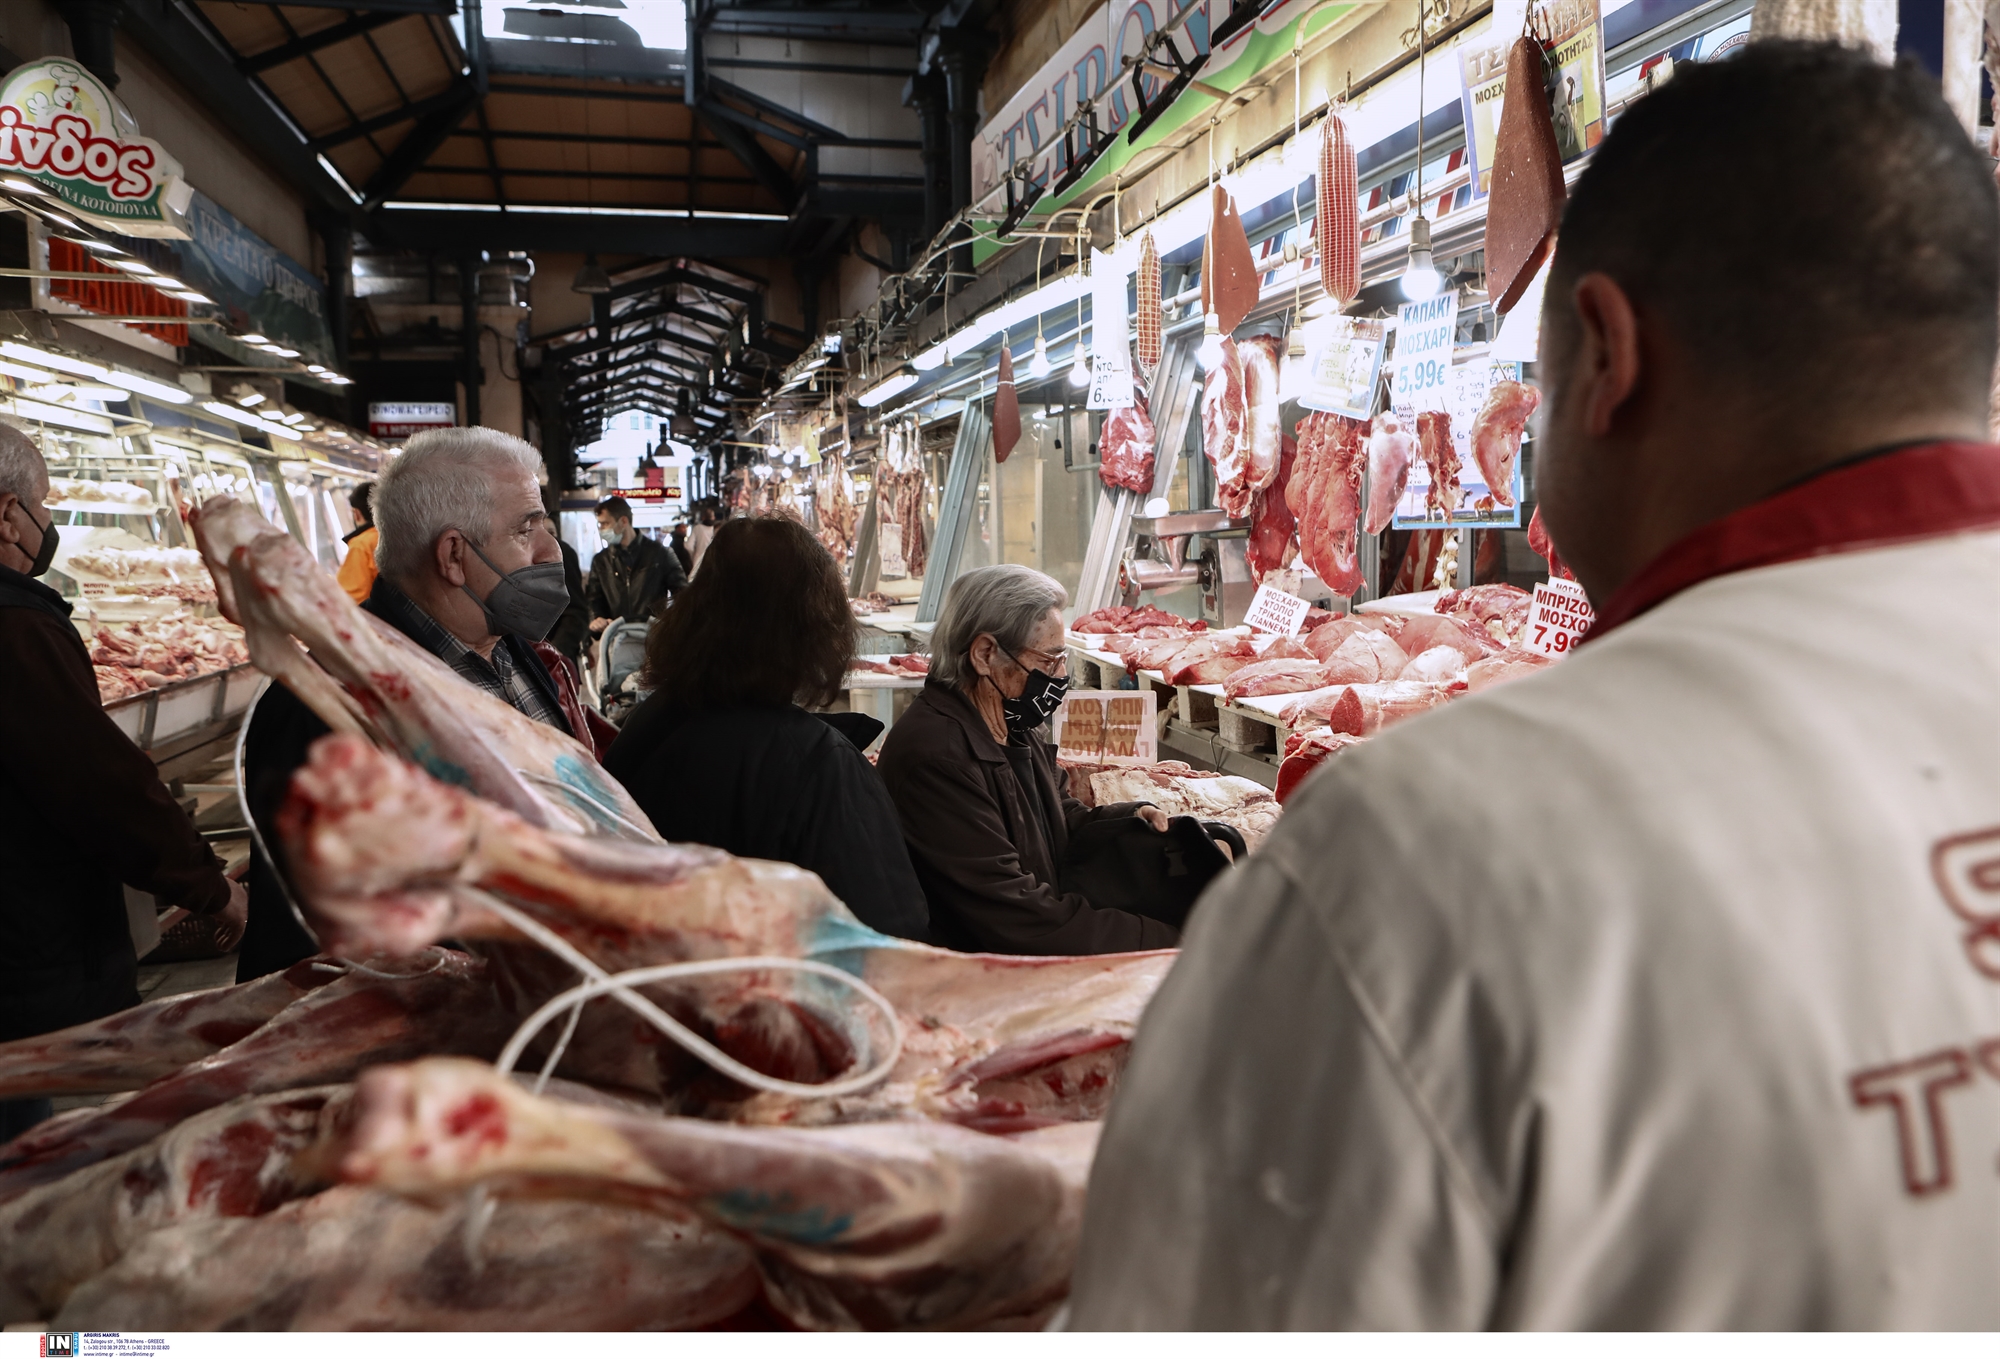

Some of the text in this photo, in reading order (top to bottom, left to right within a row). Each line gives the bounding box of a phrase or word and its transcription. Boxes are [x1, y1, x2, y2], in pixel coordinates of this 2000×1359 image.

[1475, 82, 1506, 105] ΜΟΣΧ
[1001, 0, 1290, 213] ΤΣΙΡΩΝ
[81, 194, 158, 216] ΚΟΤΟΠΟΥΛΑ
[1403, 295, 1451, 328] ΚΑΠΑΚΙ
[1398, 325, 1452, 357] ΜΟΣΧΑΡΙ
[1398, 359, 1446, 398] 5,99€
[1456, 431, 1465, 440] 6
[1262, 599, 1294, 617] ΝΤΟΠΙΟ
[1264, 589, 1301, 610] ΜΟΣΧΑΡΙ
[1535, 588, 1599, 621] ΜΠΡΙΖΟΛ
[1250, 614, 1290, 635] ΓΙΑΝΝΕΝΑ
[1257, 606, 1291, 627] ΤΡΙΚΑΛΑ
[1538, 607, 1594, 634] ΜΟΣΧΟ
